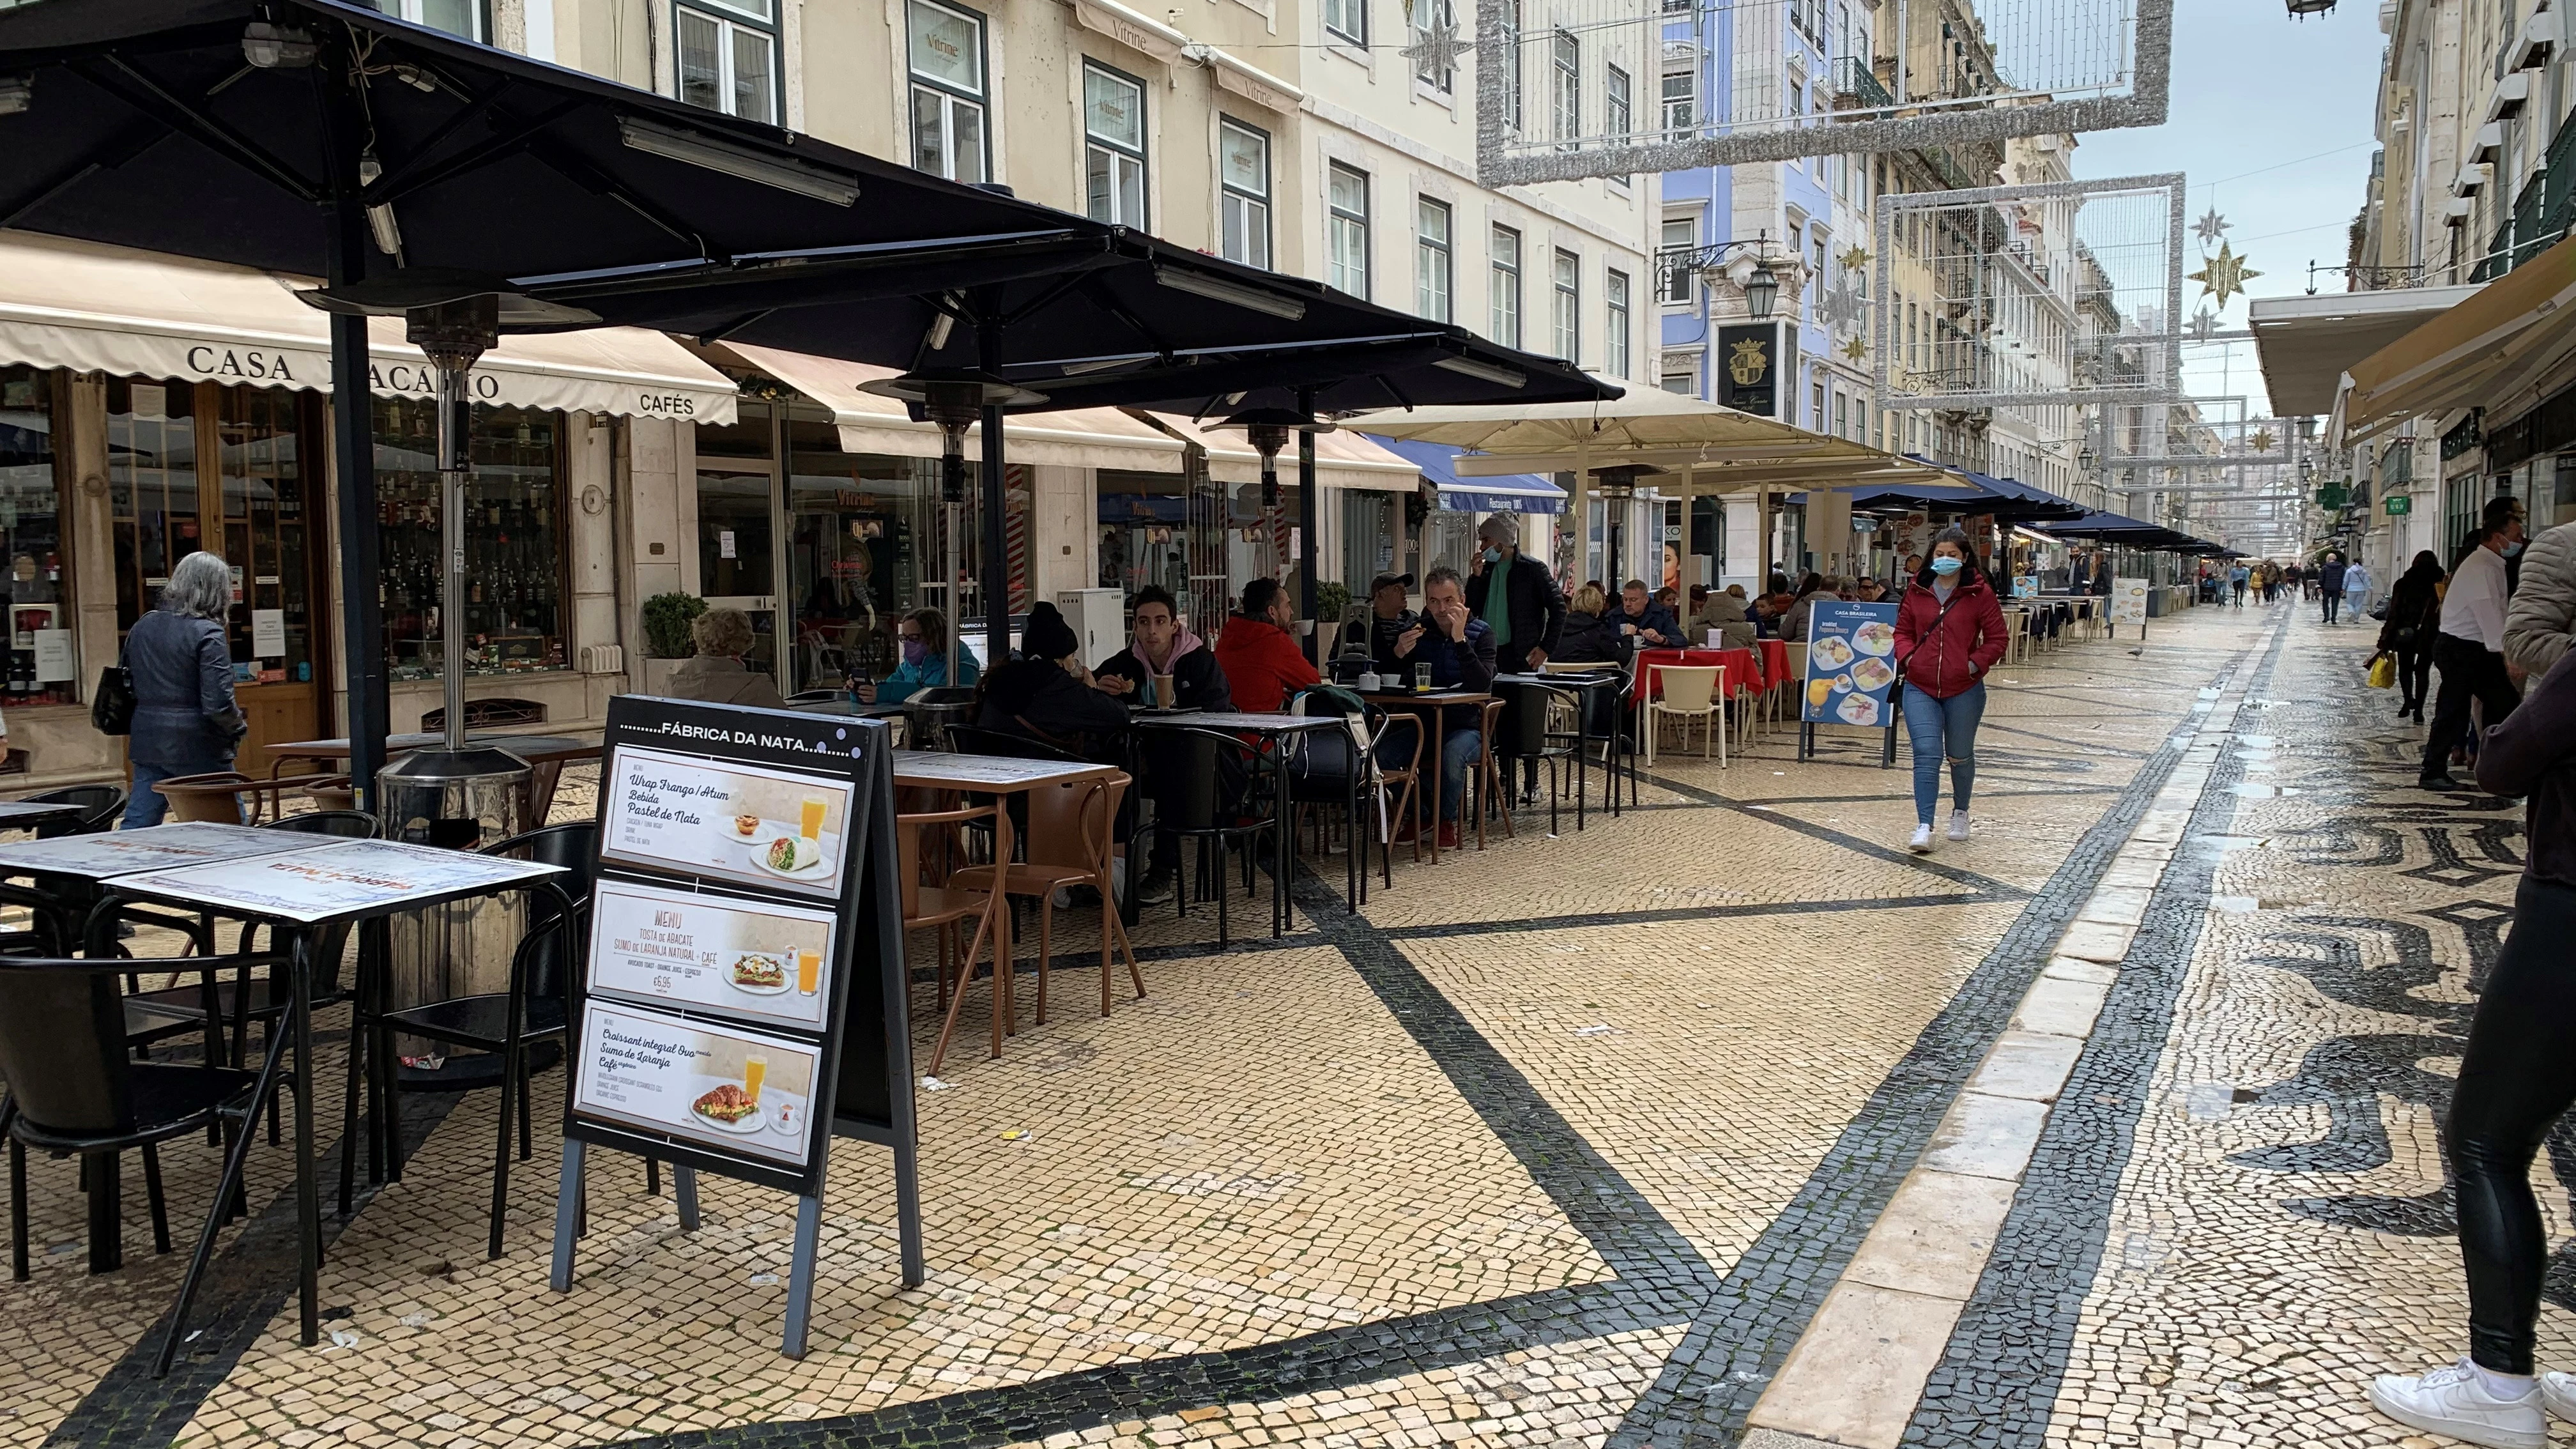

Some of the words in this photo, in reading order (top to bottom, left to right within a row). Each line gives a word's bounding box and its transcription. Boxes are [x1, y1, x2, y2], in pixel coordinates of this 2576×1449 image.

[926, 33, 958, 57] Vitrine
[1113, 19, 1146, 50] Vitrine
[1245, 80, 1272, 106] Vitrine
[1099, 98, 1124, 119] Vitrine
[187, 346, 295, 381] CASA
[328, 355, 499, 399] ACÁO
[640, 394, 694, 415] CAFÉS
[1489, 498, 1512, 509] Restaurante
[661, 721, 730, 742] FÁBRICA
[734, 731, 756, 746] DA
[628, 790, 659, 804] Bebida
[629, 774, 657, 792] Wrap
[659, 779, 694, 798] Frango
[700, 786, 730, 801] Atum
[627, 802, 661, 818] Pastel
[660, 808, 672, 820] de
[674, 810, 701, 825] Nata
[654, 909, 682, 930] MENU
[640, 928, 657, 941] TOSTA
[667, 932, 694, 947] ABACATE
[614, 939, 631, 951] SUMO
[640, 942, 667, 956] LARANJA
[668, 947, 694, 961] NATURAL
[702, 952, 717, 964] CAFÉ
[657, 963, 671, 972] ORANGE
[671, 965, 682, 974] JUICE
[654, 976, 671, 988] €6,95
[602, 1028, 642, 1046] Croissant
[643, 1039, 677, 1054] integral
[678, 1045, 696, 1057] Ovo
[599, 1056, 618, 1072] Café
[600, 1042, 624, 1056] Sumo
[624, 1048, 635, 1059] de
[636, 1051, 671, 1070] Laranja
